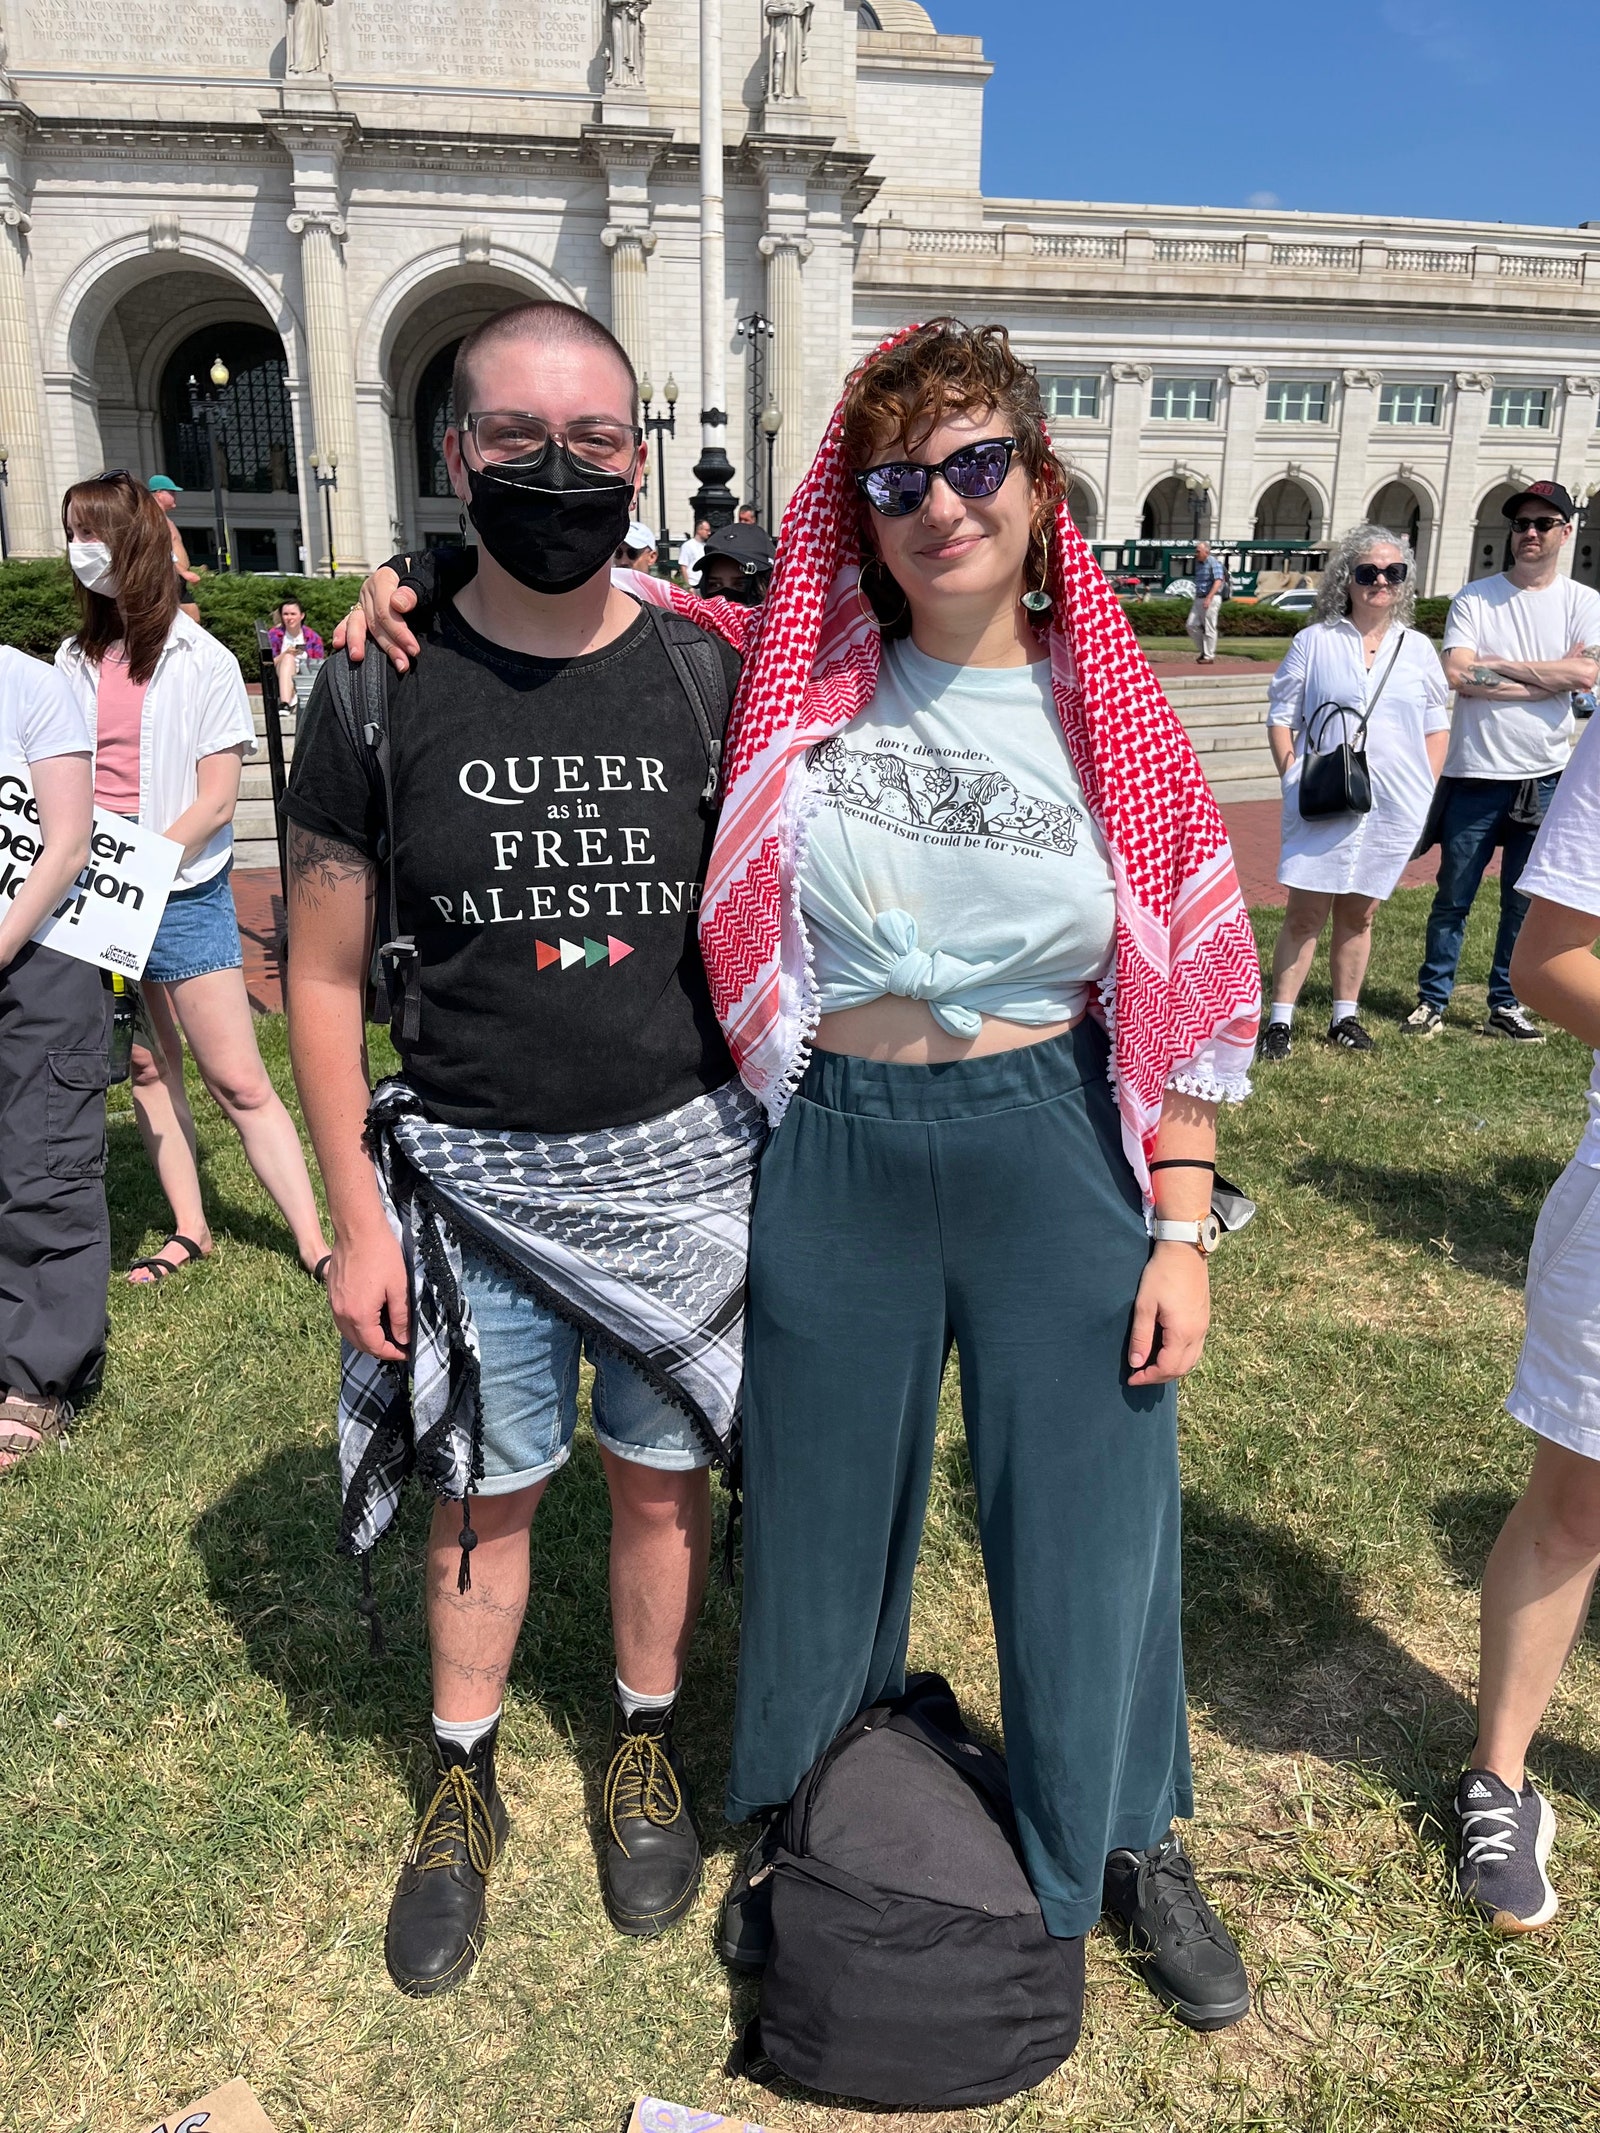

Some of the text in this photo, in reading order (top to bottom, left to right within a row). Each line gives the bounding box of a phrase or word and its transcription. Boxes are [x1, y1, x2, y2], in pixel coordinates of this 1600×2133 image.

[25, 9, 276, 28] NUMBERS AND LETTERS ALL TOOLS VESSELS
[76, 0, 143, 12] IMAGINATION
[149, 3, 169, 13] HAS
[175, 4, 237, 16] CONCEIVED
[241, 7, 260, 17] ALL
[348, 2, 586, 22] THE OLD MECHANIC ARTS CONTROLLING NEW
[31, 20, 272, 38] AND SHELTERS EVERY ART AND TRADE ALL
[354, 12, 579, 32] FORCES BUILD NEW HIGHWAYS FOR GOODS
[33, 30, 270, 48] PHILOSOPHY AND POETRY AND ALL POLITIES
[351, 23, 587, 43] AND MEN OVERRIDE THE OCEAN AND MAKE
[358, 33, 579, 52] THE VERY ETHER CARRY HUMAN THOUGHT
[60, 49, 248, 65] THE TRUTH SHALL MAKE YOU FREE
[358, 50, 581, 69] THE DESERT SHALL REJOICE AND BLOSSOM
[437, 64, 504, 76] AS THE ROSE
[875, 737, 909, 755] don't
[913, 744, 934, 757] die
[458, 755, 669, 805] QUEER
[547, 798, 601, 819] as in
[490, 827, 656, 871] FREE
[923, 833, 960, 848] could
[963, 834, 981, 849] be
[984, 836, 1009, 852] for
[1011, 845, 1044, 860] you.
[430, 881, 703, 925] PALESTINE
